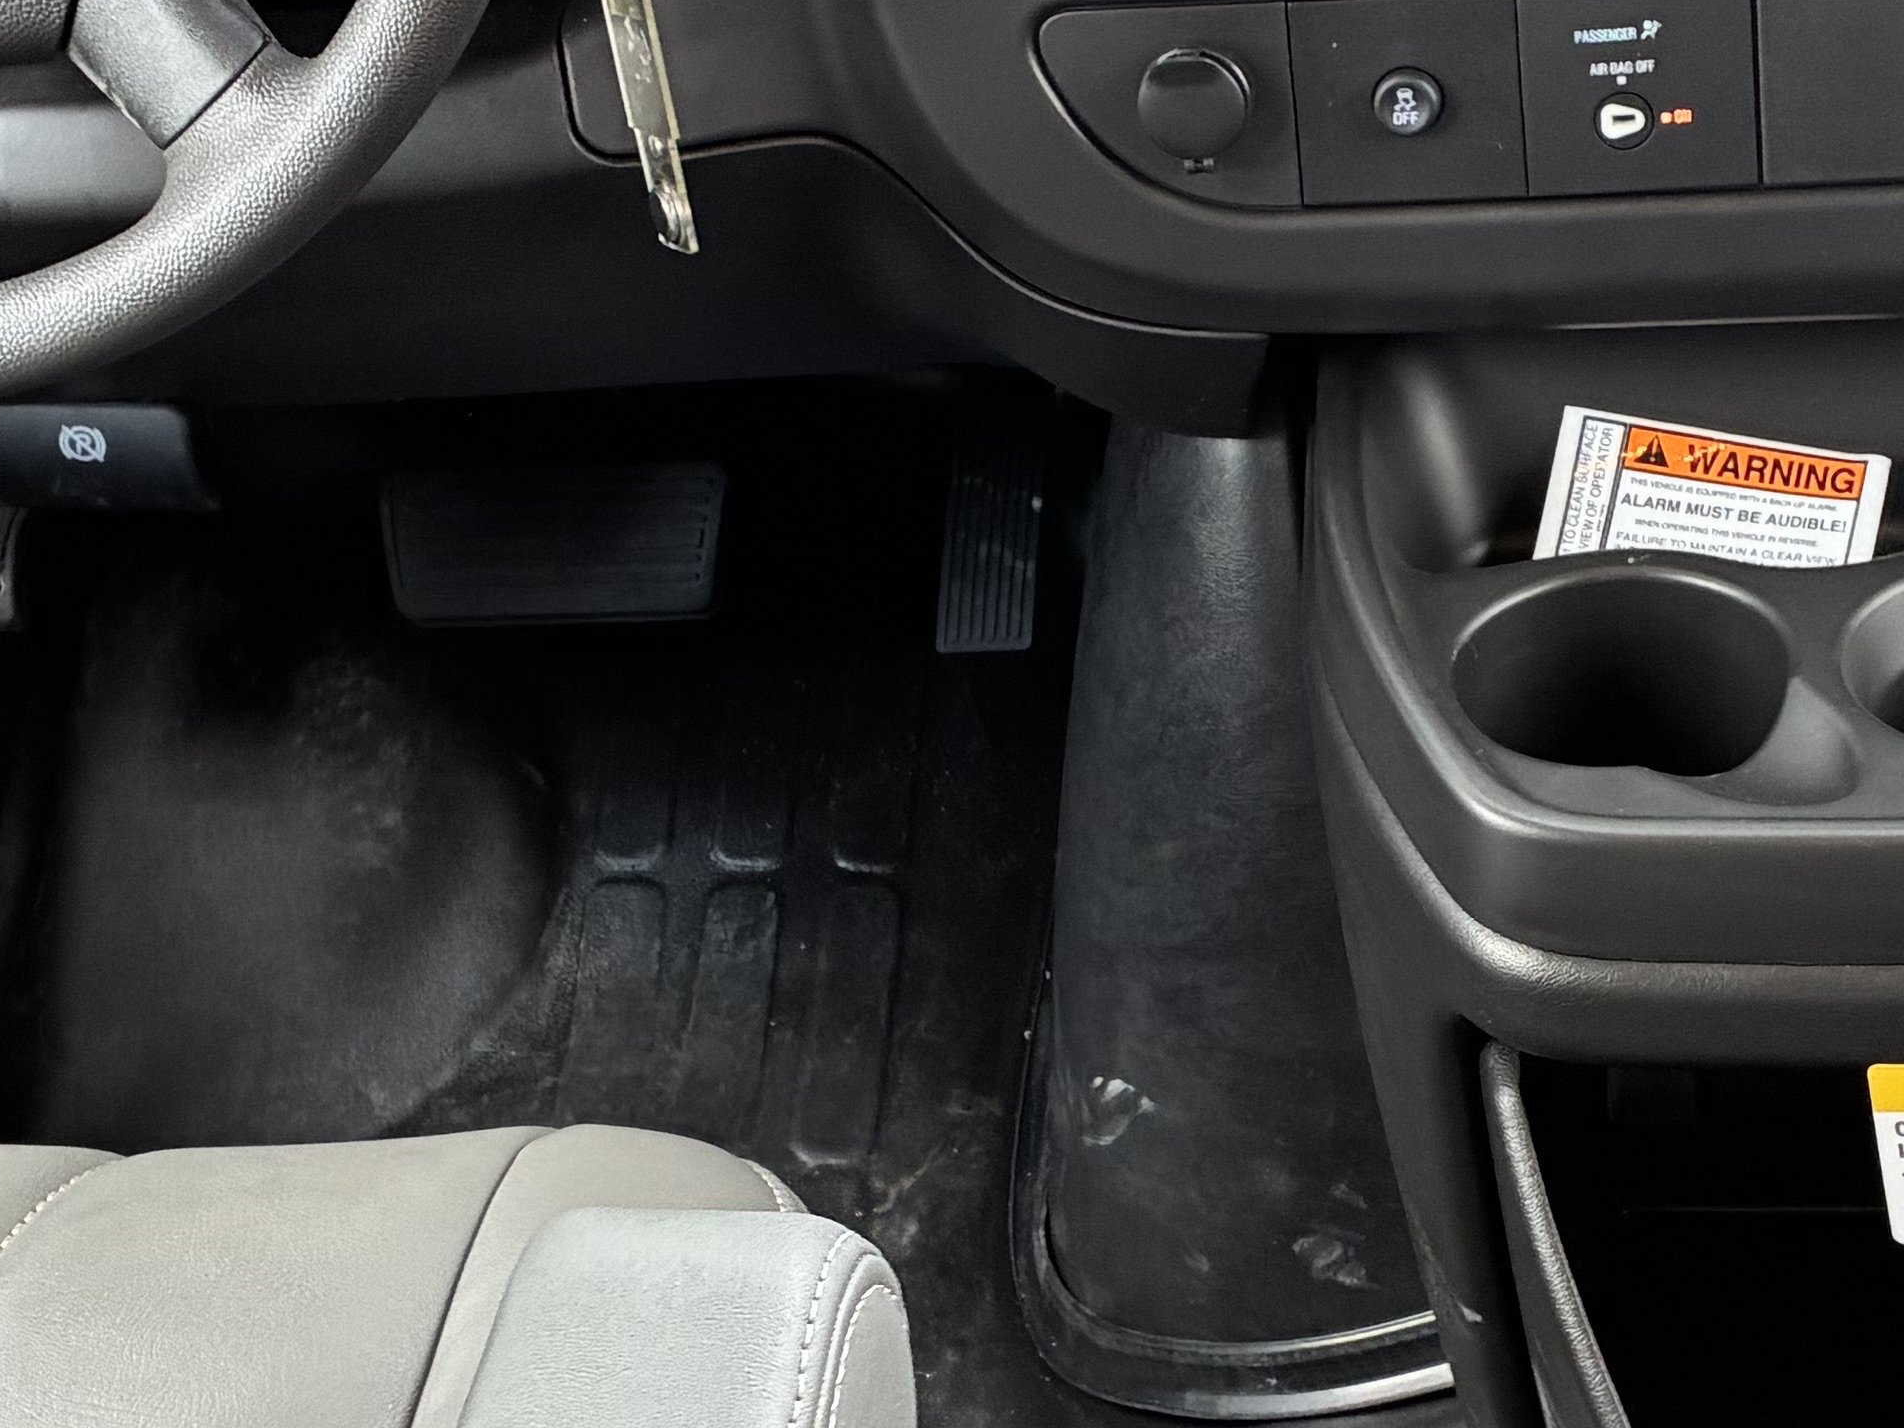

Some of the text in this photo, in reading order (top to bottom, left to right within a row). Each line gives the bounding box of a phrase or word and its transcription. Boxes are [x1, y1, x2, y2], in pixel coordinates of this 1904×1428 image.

[1573, 27, 1637, 44] PASSENGER
[1590, 59, 1655, 76] AIR BAG OFF
[1392, 110, 1420, 125] OFF
[1688, 443, 1856, 493] WARNING
[1620, 492, 1682, 513] ALARM
[1685, 502, 1734, 520] MUST
[1737, 509, 1762, 524] BE
